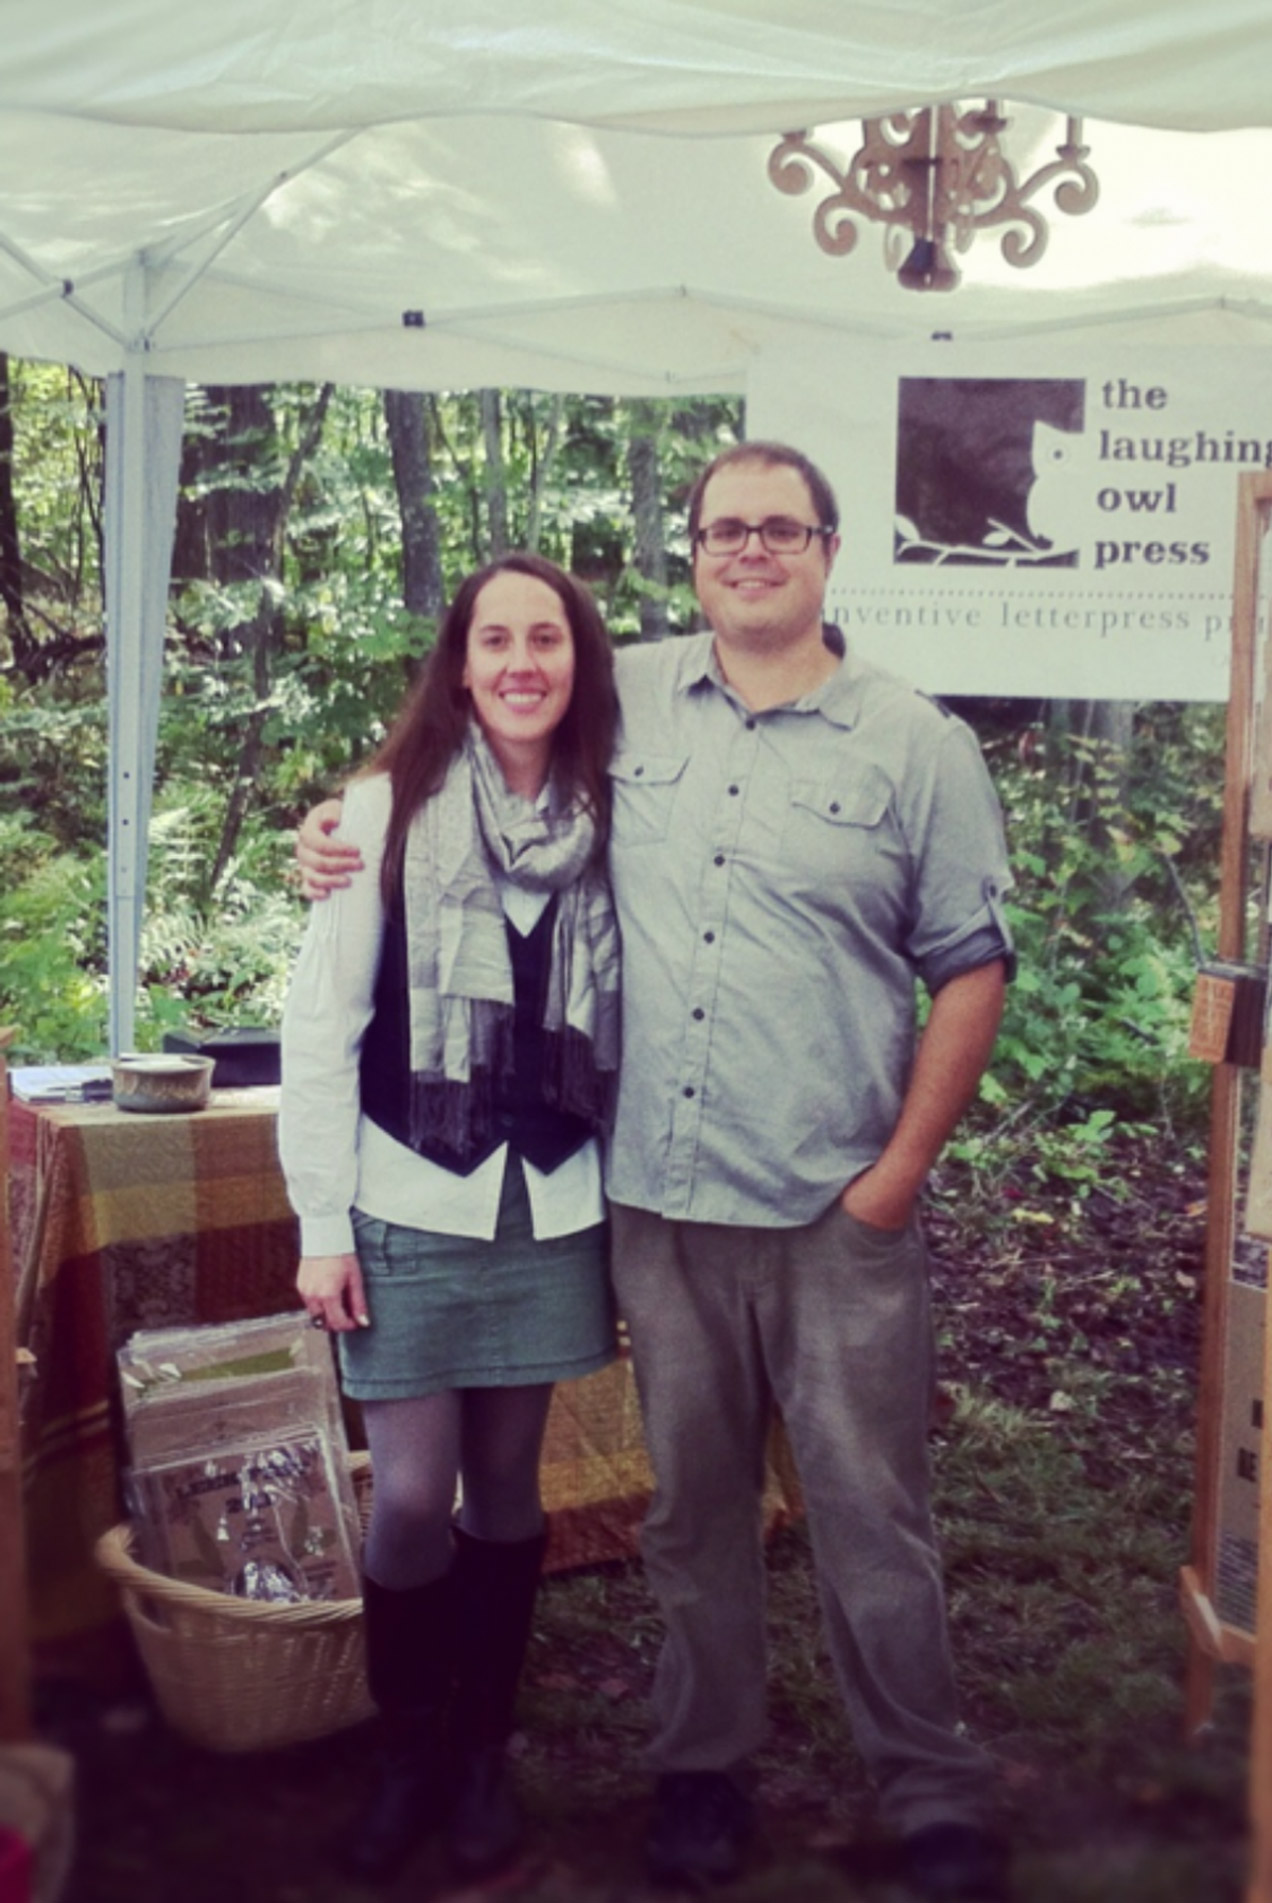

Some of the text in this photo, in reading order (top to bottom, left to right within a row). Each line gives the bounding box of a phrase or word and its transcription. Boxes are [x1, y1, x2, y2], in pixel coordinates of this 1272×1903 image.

[1102, 378, 1168, 411] the
[1096, 482, 1177, 514] owl
[1094, 540, 1211, 570] press
[1001, 601, 1191, 638] letterpress
